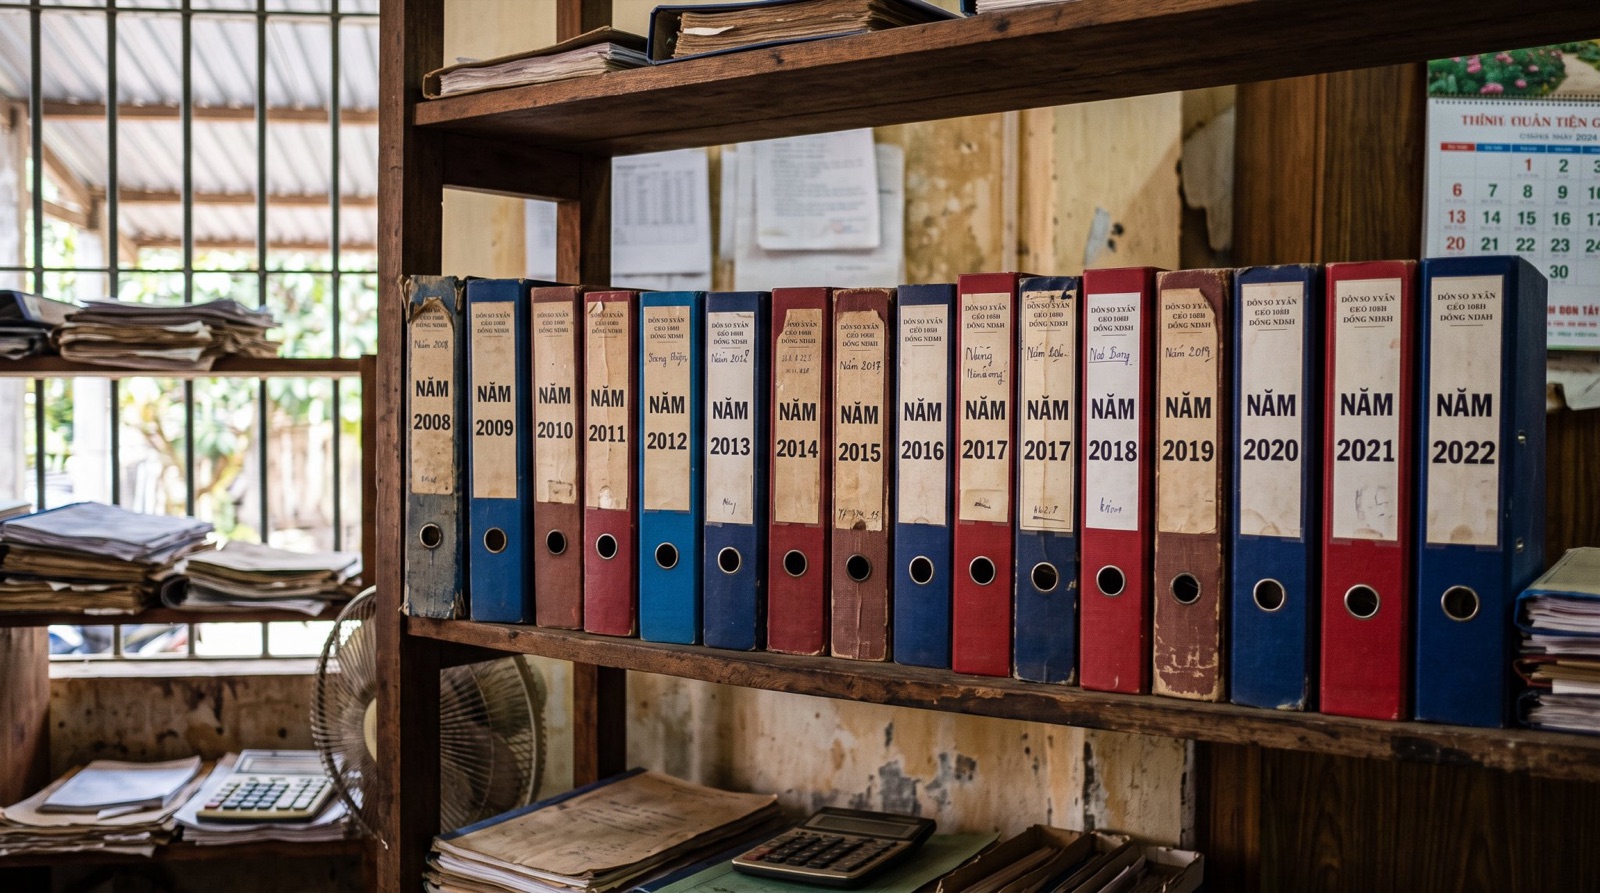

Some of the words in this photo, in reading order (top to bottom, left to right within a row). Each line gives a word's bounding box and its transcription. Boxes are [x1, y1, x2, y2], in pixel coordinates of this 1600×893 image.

[1525, 158, 1531, 171] 1
[1559, 159, 1569, 173] 2
[1593, 160, 1600, 173] 3
[1452, 183, 1462, 197] 6
[1488, 183, 1498, 197] 7
[1523, 184, 1533, 198] 8
[1558, 185, 1568, 199] 9
[1448, 210, 1466, 224] 13
[1482, 210, 1501, 224] 14
[1518, 211, 1536, 225] 15
[1552, 212, 1571, 226] 16
[1446, 236, 1466, 250] 20
[1481, 237, 1498, 251] 21
[1516, 237, 1536, 251] 22
[1551, 238, 1570, 252] 23
[1549, 265, 1569, 279] 30
[1188, 346, 1211, 358] 2019
[416, 376, 449, 397] NĂM
[477, 381, 511, 402] NĂM
[538, 383, 571, 404] NĂM
[591, 385, 624, 408] NĂM
[649, 391, 685, 414] NĂM
[712, 397, 748, 420] NĂM
[779, 398, 816, 421] NĂM
[904, 397, 942, 422] NĂM
[965, 395, 1006, 420] NĂM
[1027, 395, 1069, 420] NĂM
[1091, 393, 1135, 420] NĂM
[1165, 391, 1212, 419] NĂM
[1246, 389, 1296, 417] NĂM
[1340, 387, 1393, 416] NĂM
[1436, 388, 1492, 417] NĂM
[413, 413, 451, 431] 2008
[841, 401, 878, 424] NĂM
[476, 419, 514, 436] 2009
[537, 421, 574, 439] 2010
[589, 424, 626, 443] 2011
[647, 432, 688, 450] 2012
[710, 436, 750, 456] 2013
[776, 439, 819, 458] 2014
[901, 440, 944, 460] 2016
[962, 439, 1008, 460] 2017
[1024, 440, 1071, 461] 2017
[1088, 440, 1138, 462] 2018
[1162, 439, 1214, 462] 2019
[1243, 438, 1299, 462] 2020
[1337, 438, 1395, 462] 2021
[838, 442, 881, 462] 2015
[1432, 440, 1495, 465] 2022
